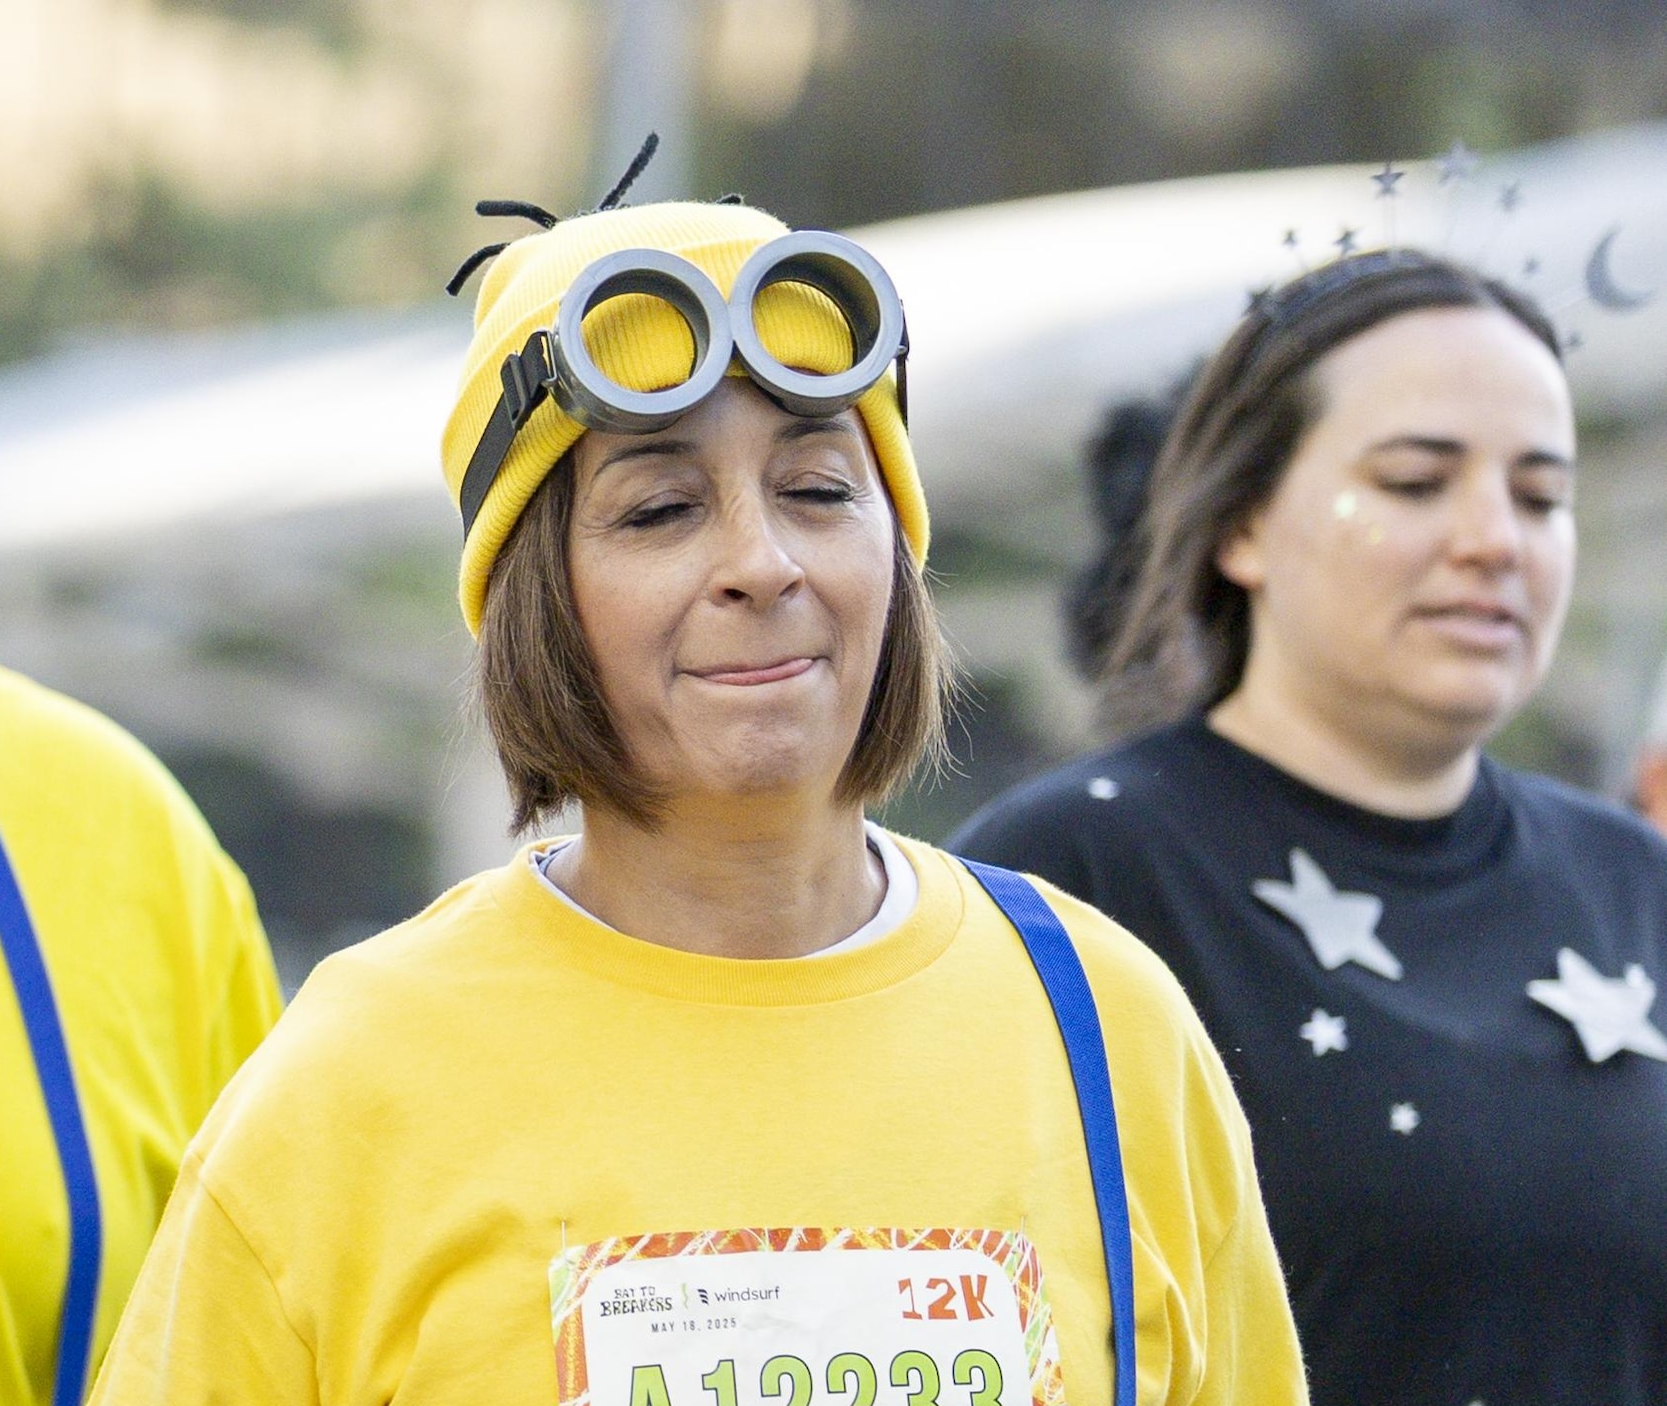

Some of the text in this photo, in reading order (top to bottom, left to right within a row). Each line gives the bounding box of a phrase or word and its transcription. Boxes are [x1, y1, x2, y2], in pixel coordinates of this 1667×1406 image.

[714, 1286, 780, 1302] windsurf
[898, 1275, 994, 1321] 12K
[600, 1297, 673, 1317] BREAKERS
[651, 1322, 675, 1333] MAY
[707, 1317, 737, 1330] 2025
